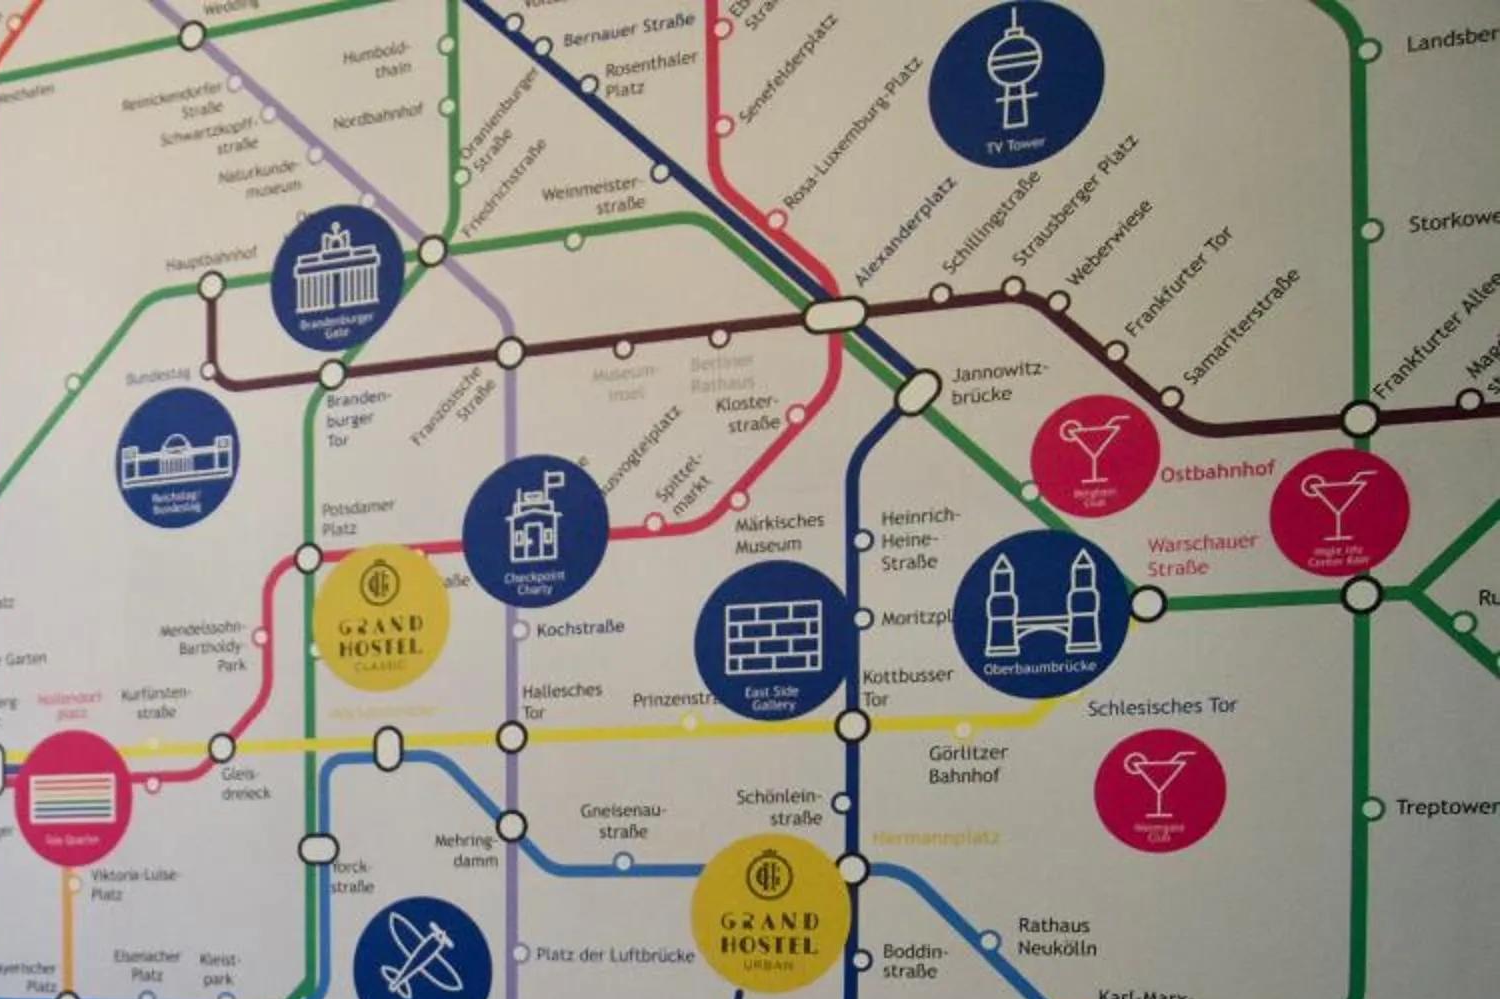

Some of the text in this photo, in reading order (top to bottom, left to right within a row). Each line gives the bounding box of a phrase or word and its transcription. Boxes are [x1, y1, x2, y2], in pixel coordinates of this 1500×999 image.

[563, 13, 697, 48] Bernauer Straße
[605, 51, 699, 78] Rosenthaler
[739, 12, 838, 126] Senefelderplatz
[605, 82, 646, 98] Platz
[181, 101, 225, 120] Straße
[333, 102, 424, 130] Nordbahnhof
[783, 55, 924, 211] Rosa-Luxemburg-Platz
[216, 137, 260, 156] straße
[473, 128, 514, 173] Straße
[986, 137, 1047, 154] TV Tower
[246, 179, 303, 200] museum
[596, 195, 646, 216] straße
[1012, 133, 1140, 268] Strausberger Platz
[855, 176, 958, 288] Alexanderplatz
[942, 170, 1043, 277] Schillingstraße
[1065, 198, 1155, 288] Weberwiese
[165, 244, 258, 272] Hauptbahnhof
[1125, 225, 1233, 338] Frankfurter Tor
[300, 312, 374, 332] Brandenburger
[1183, 268, 1300, 386] Samariterstraße
[324, 326, 350, 340] Gate
[1373, 309, 1463, 400] Frankfurter
[1461, 271, 1500, 316] Allee
[951, 362, 1050, 384] Jannowitz-
[327, 390, 393, 408] Branden-
[456, 378, 497, 424] Straße
[716, 396, 780, 413] Kloster-
[951, 387, 1013, 407] brücke
[327, 411, 375, 430] burger
[728, 417, 781, 433] straße
[327, 434, 350, 448] Tor
[655, 453, 704, 504] Spittel-
[1161, 458, 1277, 484] Ostbahnhof
[672, 476, 713, 518] markt
[322, 498, 396, 517] Potsdamer
[881, 506, 961, 526] Heinrich-
[322, 521, 357, 536] Platz
[735, 513, 825, 532] Märkisches
[735, 536, 803, 555] Museum
[881, 531, 939, 549] Heine-
[1148, 533, 1260, 554] Warschauer
[881, 555, 938, 572] Straße
[1148, 559, 1210, 577] Straße
[504, 570, 566, 585] Checkpoint
[338, 615, 424, 637] GRAND
[537, 619, 625, 638] Kochstraße
[338, 638, 424, 658] HOSTEL
[5, 652, 48, 668] Garten
[217, 658, 248, 674] Park
[983, 659, 1098, 677] Oberbaumbrücke
[863, 667, 954, 686] Kottbusser
[523, 683, 603, 700] Hallesches
[745, 684, 799, 699] East Side
[863, 692, 889, 707] Tor
[137, 705, 178, 720] straße
[523, 705, 547, 720] Tor
[751, 697, 797, 713] Gallery
[1088, 697, 1239, 718] Schlesisches Tor
[929, 745, 1010, 762] Görlitzer
[929, 768, 1001, 786] Bahnhof
[737, 789, 823, 806] Schönlein-
[580, 803, 667, 820] Gneisenau-
[1396, 798, 1500, 820] Treptower
[770, 811, 823, 827] straße
[599, 824, 649, 840] straße
[872, 829, 1000, 848] Hermannplatz
[435, 834, 499, 850] Mehring-
[453, 854, 499, 868] damm
[92, 888, 123, 902] Platz
[720, 911, 820, 931] GRAND
[1019, 917, 1090, 933] Rathaus
[720, 935, 820, 955] HOSTEL
[882, 943, 949, 960] Boddin-
[1018, 940, 1098, 957] Neukölln
[536, 946, 696, 965] Platz der Luftbrücke
[743, 959, 795, 971] URBAN
[131, 968, 163, 983] Platz
[203, 972, 234, 988] park
[882, 963, 938, 980] straße
